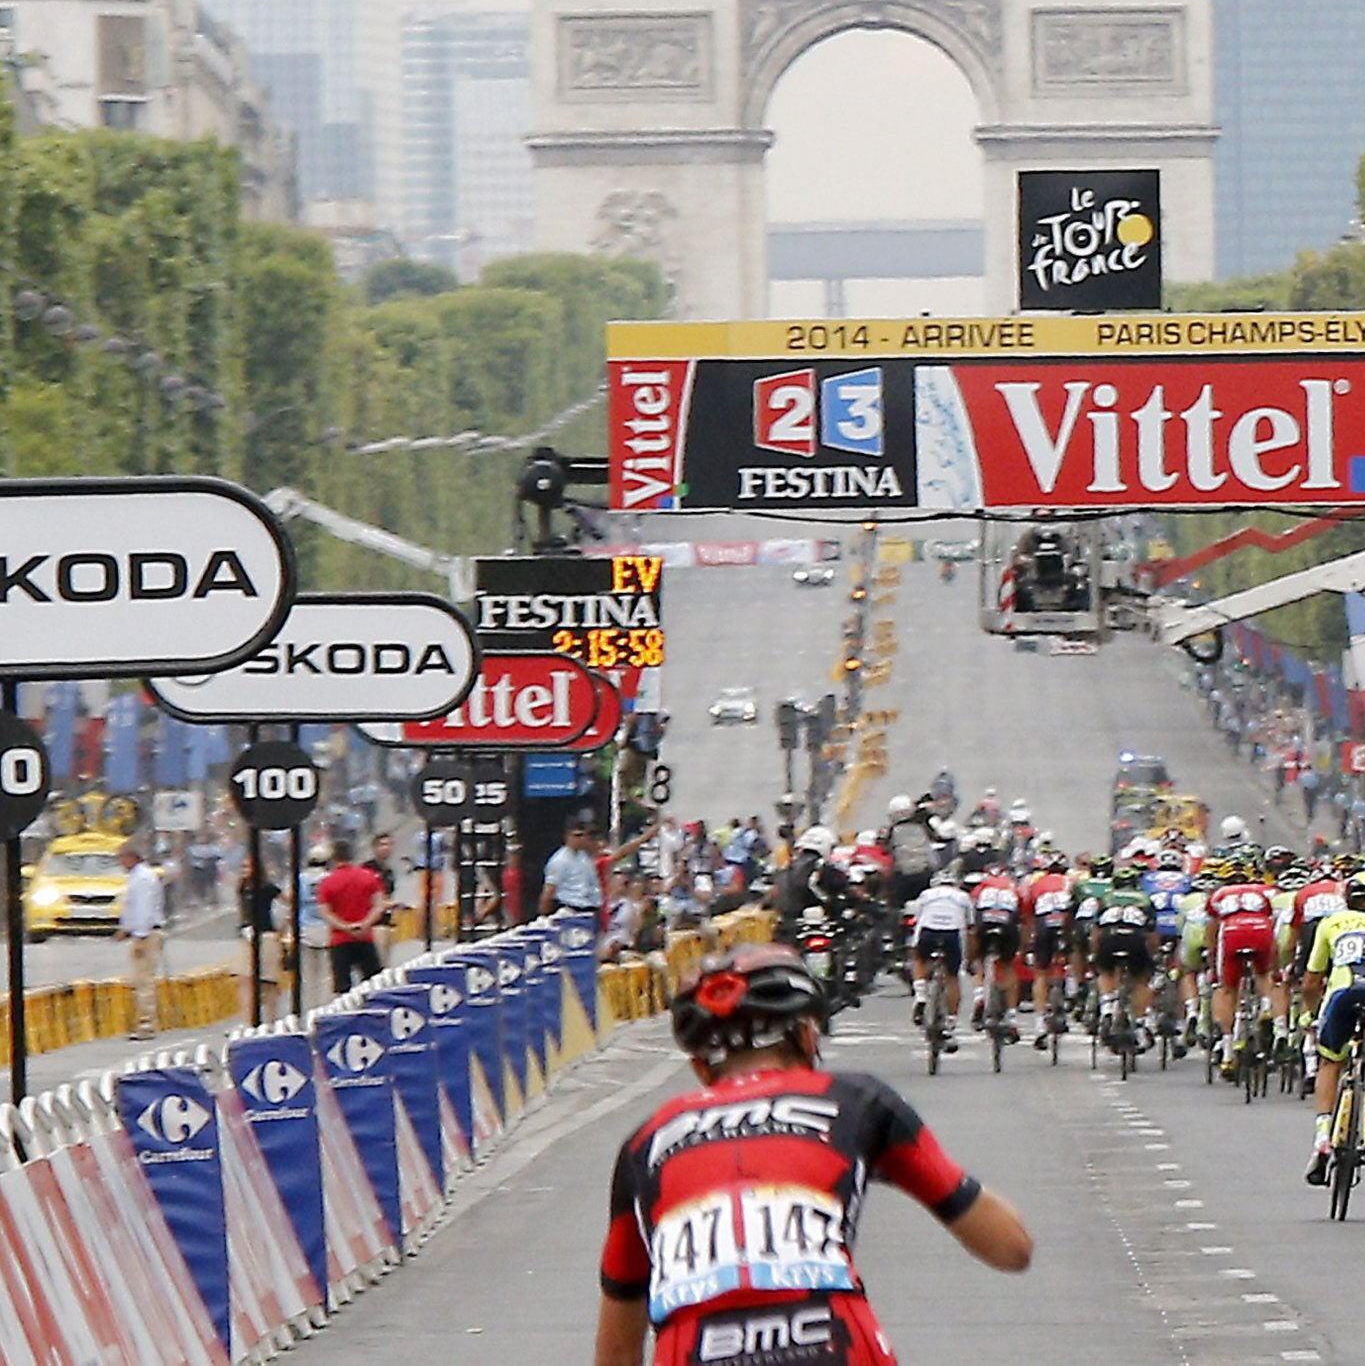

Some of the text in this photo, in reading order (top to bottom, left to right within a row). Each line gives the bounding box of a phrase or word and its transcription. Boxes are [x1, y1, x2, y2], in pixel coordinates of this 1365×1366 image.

[786, 324, 870, 350] 2014
[1097, 322, 1182, 346] PARIS
[767, 384, 883, 441] 2 3
[620, 369, 673, 508] Vittel
[994, 378, 1343, 495] Vittel
[736, 465, 903, 500] FESTINA
[611, 556, 663, 593] EV
[478, 594, 661, 628] FESTINA
[231, 766, 317, 800] 100
[421, 779, 467, 805] 50
[700, 1305, 833, 1364] BMC
